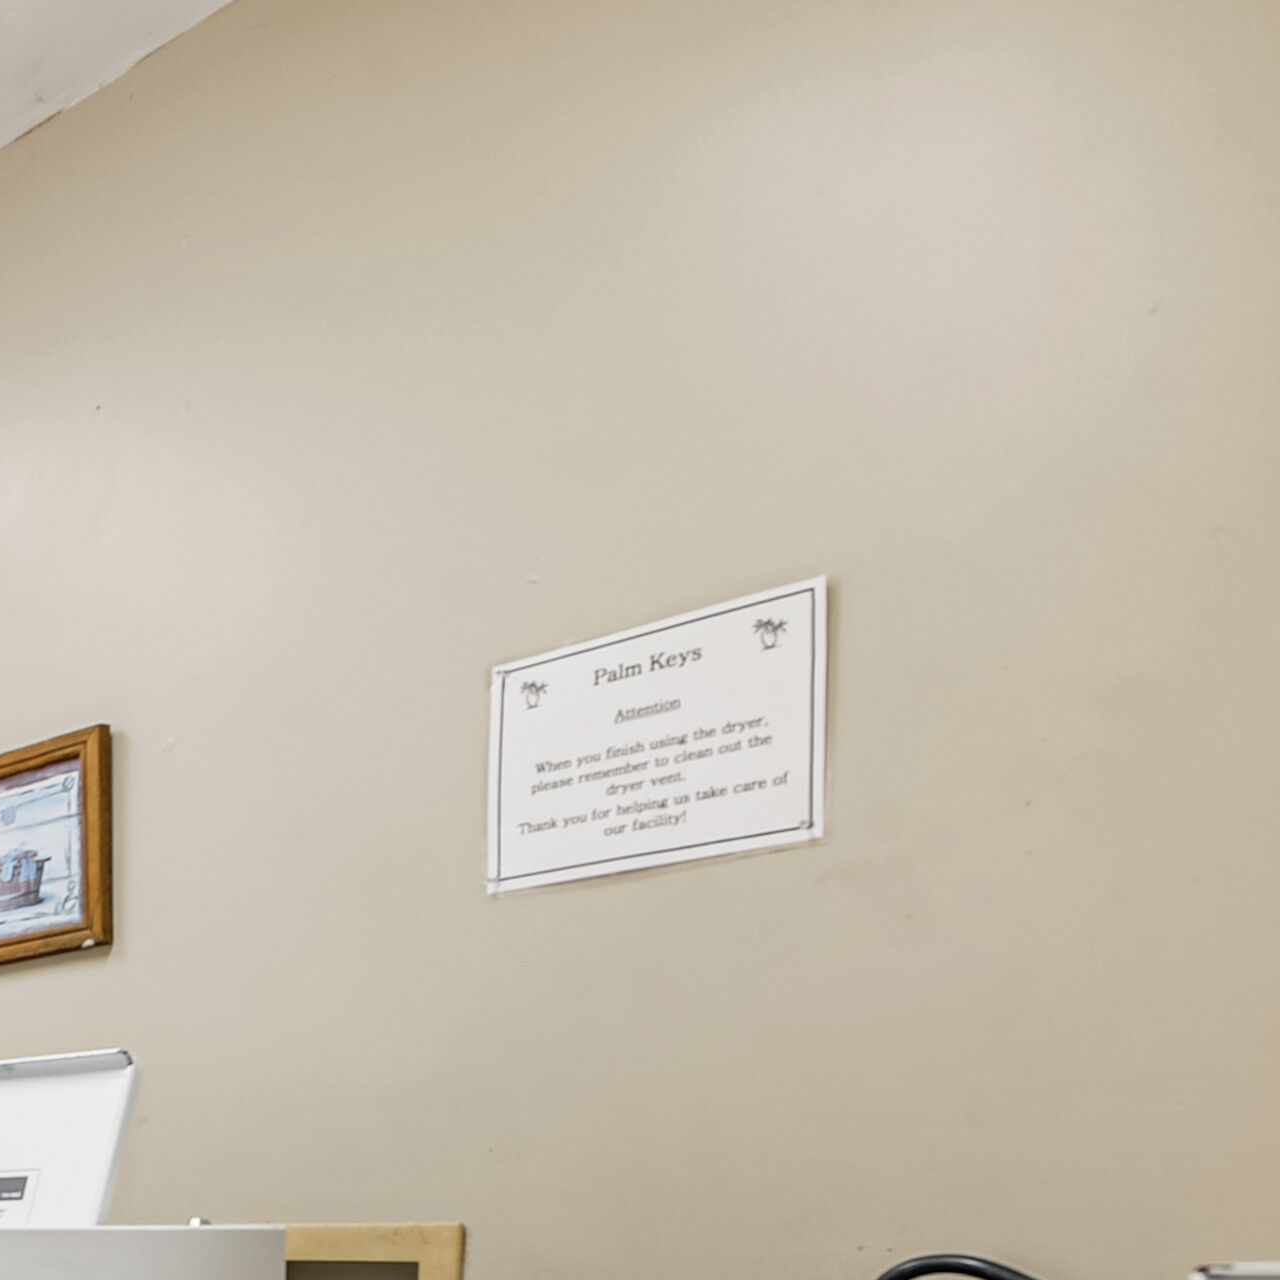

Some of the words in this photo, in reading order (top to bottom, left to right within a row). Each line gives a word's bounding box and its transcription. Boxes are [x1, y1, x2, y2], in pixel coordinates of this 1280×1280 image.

[593, 662, 643, 686] Palm
[649, 647, 703, 672] Keys
[613, 699, 682, 725] Attention
[530, 777, 574, 797] please
[577, 760, 650, 784] remember
[654, 756, 670, 768] to
[673, 747, 714, 765] clean
[718, 739, 743, 756] out
[747, 734, 774, 750] the
[534, 759, 573, 774] When
[575, 753, 602, 768] you
[605, 742, 645, 760] finish
[649, 734, 689, 752] using
[692, 727, 717, 741] the
[517, 817, 559, 836] Thank
[562, 813, 589, 830] you
[591, 807, 612, 822] for
[615, 796, 670, 818] helping
[673, 794, 691, 806] us
[695, 785, 729, 801] take
[732, 779, 768, 795] care
[772, 769, 791, 786] of
[605, 779, 646, 797] dryer
[603, 822, 628, 837] our
[632, 809, 688, 832] facility!
